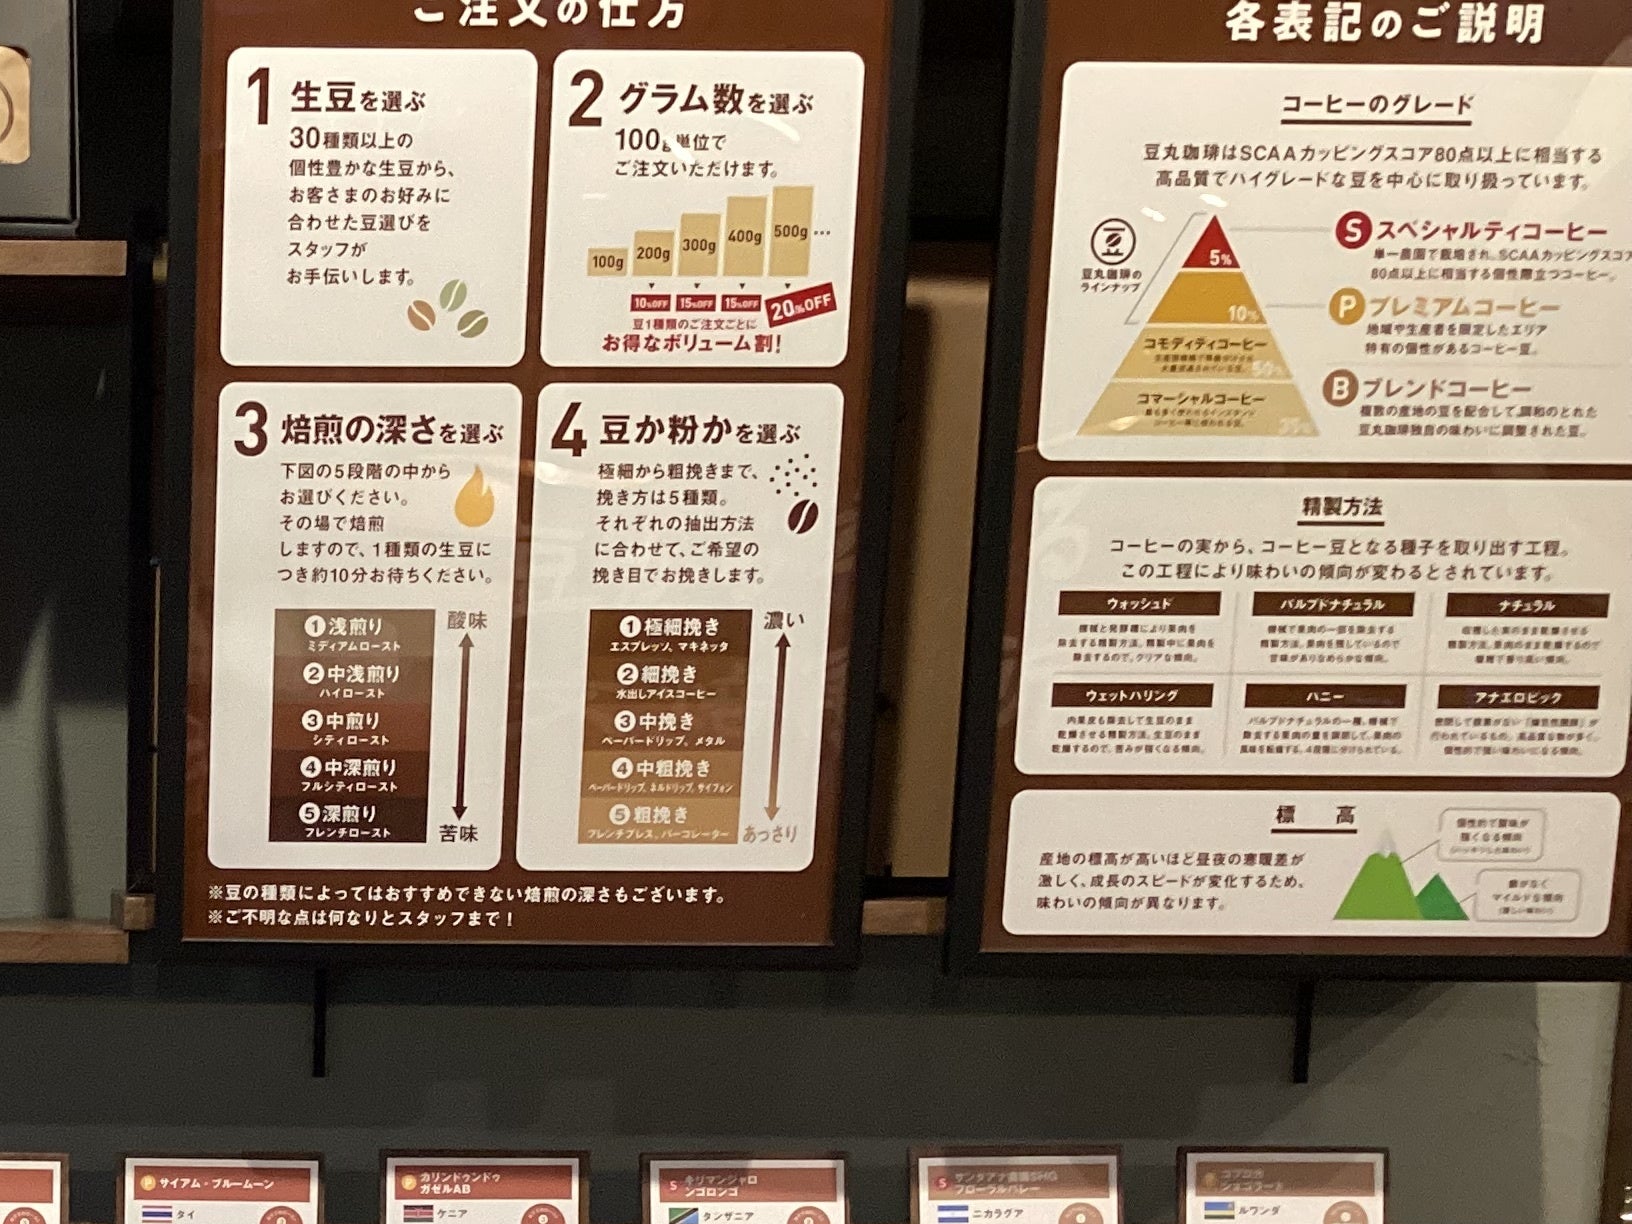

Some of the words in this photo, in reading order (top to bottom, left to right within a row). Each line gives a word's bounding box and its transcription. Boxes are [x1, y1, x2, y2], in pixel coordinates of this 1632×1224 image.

[1226, 3, 1545, 43] 各表記のご説明
[247, 67, 270, 125] 1
[291, 80, 426, 113] 生豆を選ぶ
[569, 68, 604, 126] 2
[619, 82, 814, 115] グラム数を選ぶ
[1282, 94, 1474, 115] コーヒーのグレード
[289, 126, 413, 150] 30種類以上の
[1144, 143, 1602, 165] 豆丸珈琲はSCAAカッピングスコア80点以上に相当する
[289, 158, 455, 178] 個性豊かな生豆から、
[614, 158, 778, 179] ご注文いただけます。
[1156, 170, 1589, 190] 高品質でハイグレードな豆を中心に取り扱っています。
[289, 185, 450, 204] お客さまのお好みに
[287, 213, 430, 232] 合わせた豆選びを
[1344, 217, 1362, 243] S
[1377, 220, 1608, 242] スペシャルティコーヒー
[727, 228, 762, 246] 400g
[774, 223, 809, 241] 500g
[287, 240, 366, 258] スタッフが
[636, 245, 671, 264] 200g
[682, 237, 717, 255] 300g
[591, 254, 625, 273] 100g
[1210, 251, 1233, 266] 5%
[286, 267, 414, 286] お手伝いします。
[770, 290, 832, 321] 20%OFF
[1339, 296, 1355, 318] P
[1370, 297, 1560, 317] プレミアムコーヒー
[632, 318, 758, 331] 豆1種類のご注文ごとに
[603, 334, 781, 355] お得なボリューム割!
[1332, 377, 1350, 399] B
[1364, 379, 1531, 398] ブレンドコーヒー
[233, 401, 267, 456] 3
[281, 414, 504, 445] 焙煎の深さを選ぶ
[550, 401, 587, 457] 4
[600, 414, 801, 445] 豆か粉かを選ぶ
[281, 462, 451, 482] 下図の5段階の中から
[598, 463, 758, 482] 極細から粗挽きまで、
[280, 489, 408, 507] お選びください。
[597, 489, 727, 507] 挽き方は5種類。
[1302, 497, 1383, 517] 精製方法
[280, 515, 384, 533] その場で焙煎
[596, 515, 754, 533] それぞれの抽出方法
[279, 541, 491, 559] しますので、1種類の生豆に
[594, 541, 758, 559] に合わせて、ご希望の
[277, 567, 493, 585] つき約10分お待ちください。
[592, 567, 765, 586] 挽き目でお挽きします。
[1121, 562, 1553, 582] この工程により味わいの傾向が変わるとされています。
[1107, 596, 1171, 611] ウォッシュド
[1498, 599, 1556, 612] ナチュラル
[448, 612, 487, 631] 酸味
[764, 610, 804, 630] 濃い
[307, 641, 401, 652] ミディアムロースト
[319, 689, 385, 699] ハイロースト
[616, 689, 716, 700] 水出しアイスコーヒー
[1307, 691, 1344, 703] ハニー
[312, 735, 389, 746] シティロースト
[301, 782, 398, 792] フルシティロースト
[304, 827, 391, 839] フレンチロースト
[439, 825, 479, 843] 苦味
[743, 825, 797, 844] あっさり
[1040, 850, 1305, 868] 産地の標高が高いほど昼夜の寒暖差が
[1037, 895, 1226, 912] 味わいの傾向が異なります。
[177, 1209, 195, 1220] タイ
[438, 1208, 468, 1219] ケニア
[703, 1210, 754, 1221] タンザニア
[973, 1208, 1024, 1220] ニカラグア
